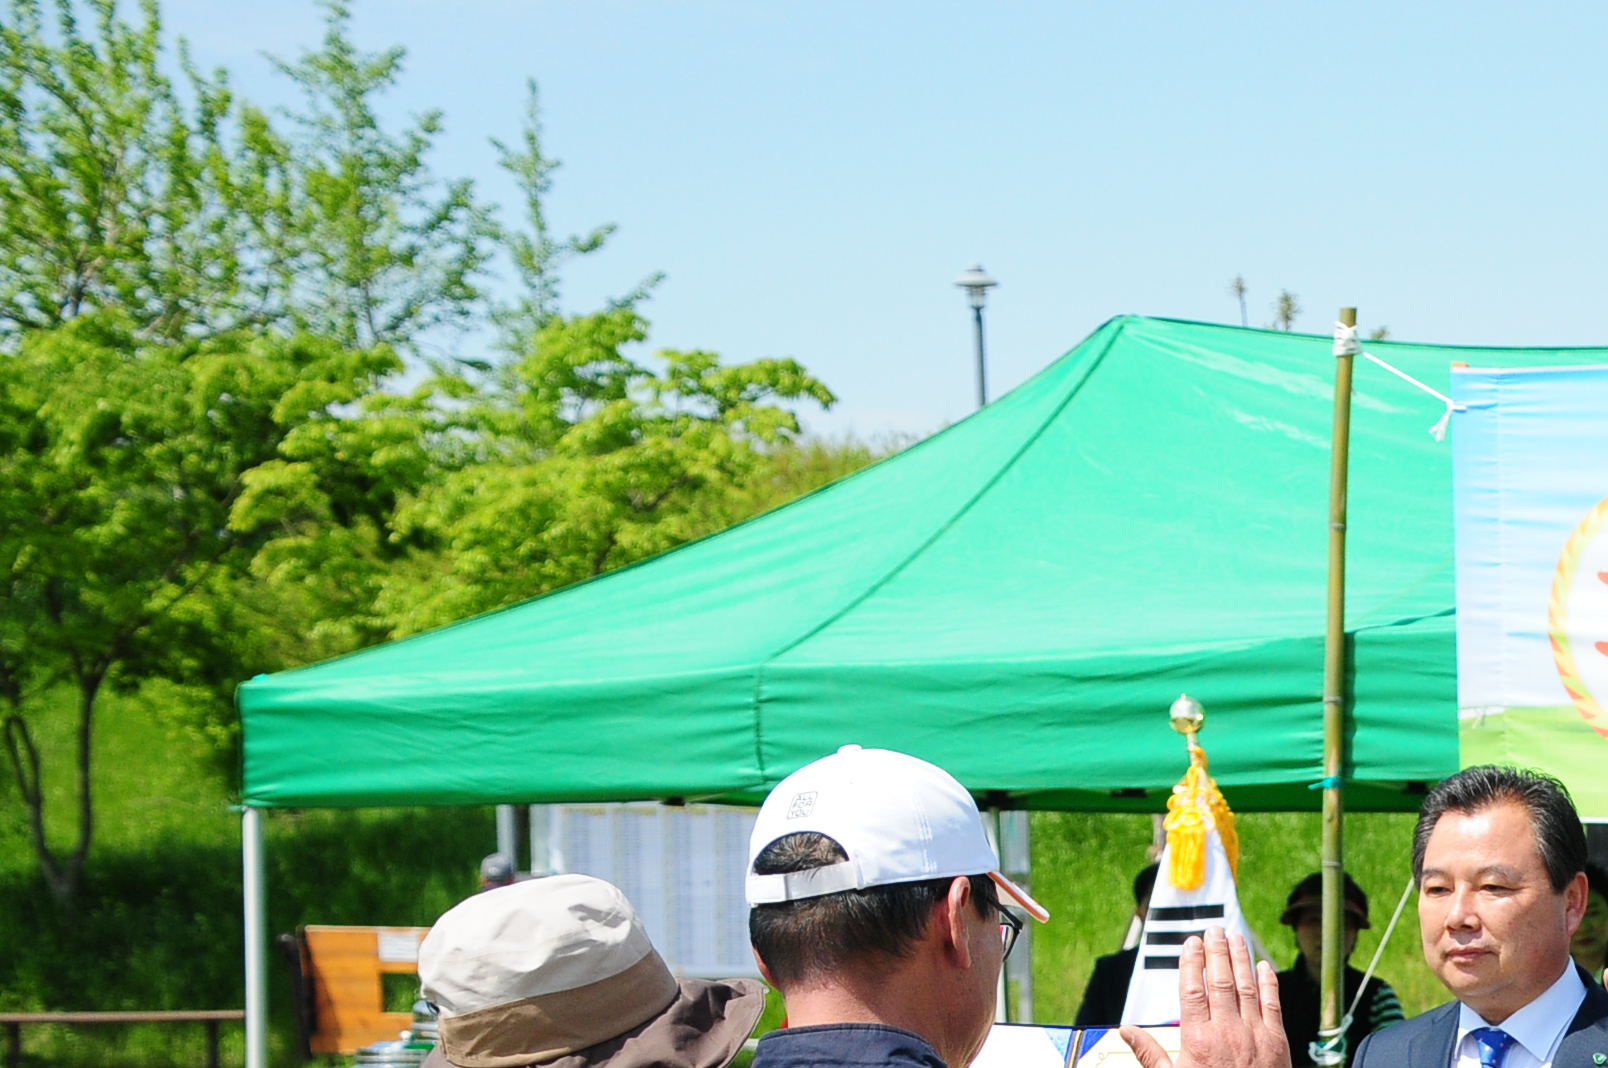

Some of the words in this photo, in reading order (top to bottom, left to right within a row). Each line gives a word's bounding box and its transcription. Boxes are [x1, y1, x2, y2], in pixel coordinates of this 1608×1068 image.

[796, 793, 814, 801] ALL
[792, 800, 813, 809] FOR
[791, 809, 810, 818] YOU
